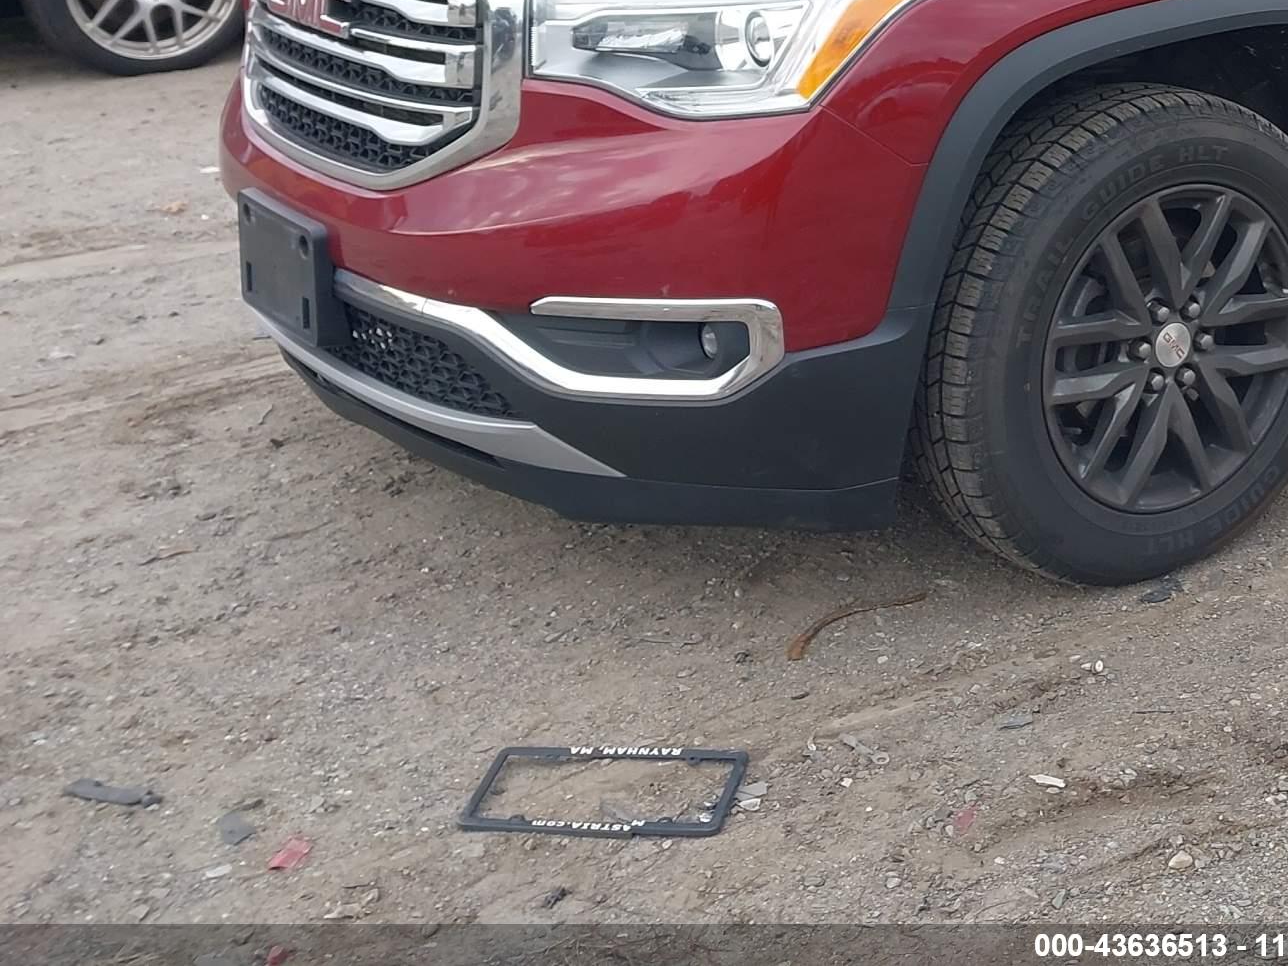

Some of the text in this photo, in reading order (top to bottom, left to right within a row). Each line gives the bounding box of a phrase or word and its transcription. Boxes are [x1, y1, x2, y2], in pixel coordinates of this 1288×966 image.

[1014, 144, 1229, 348] TRAIL GUIDE HLT
[1162, 332, 1185, 359] GMC
[570, 745, 683, 757] RAYNHAM, MA
